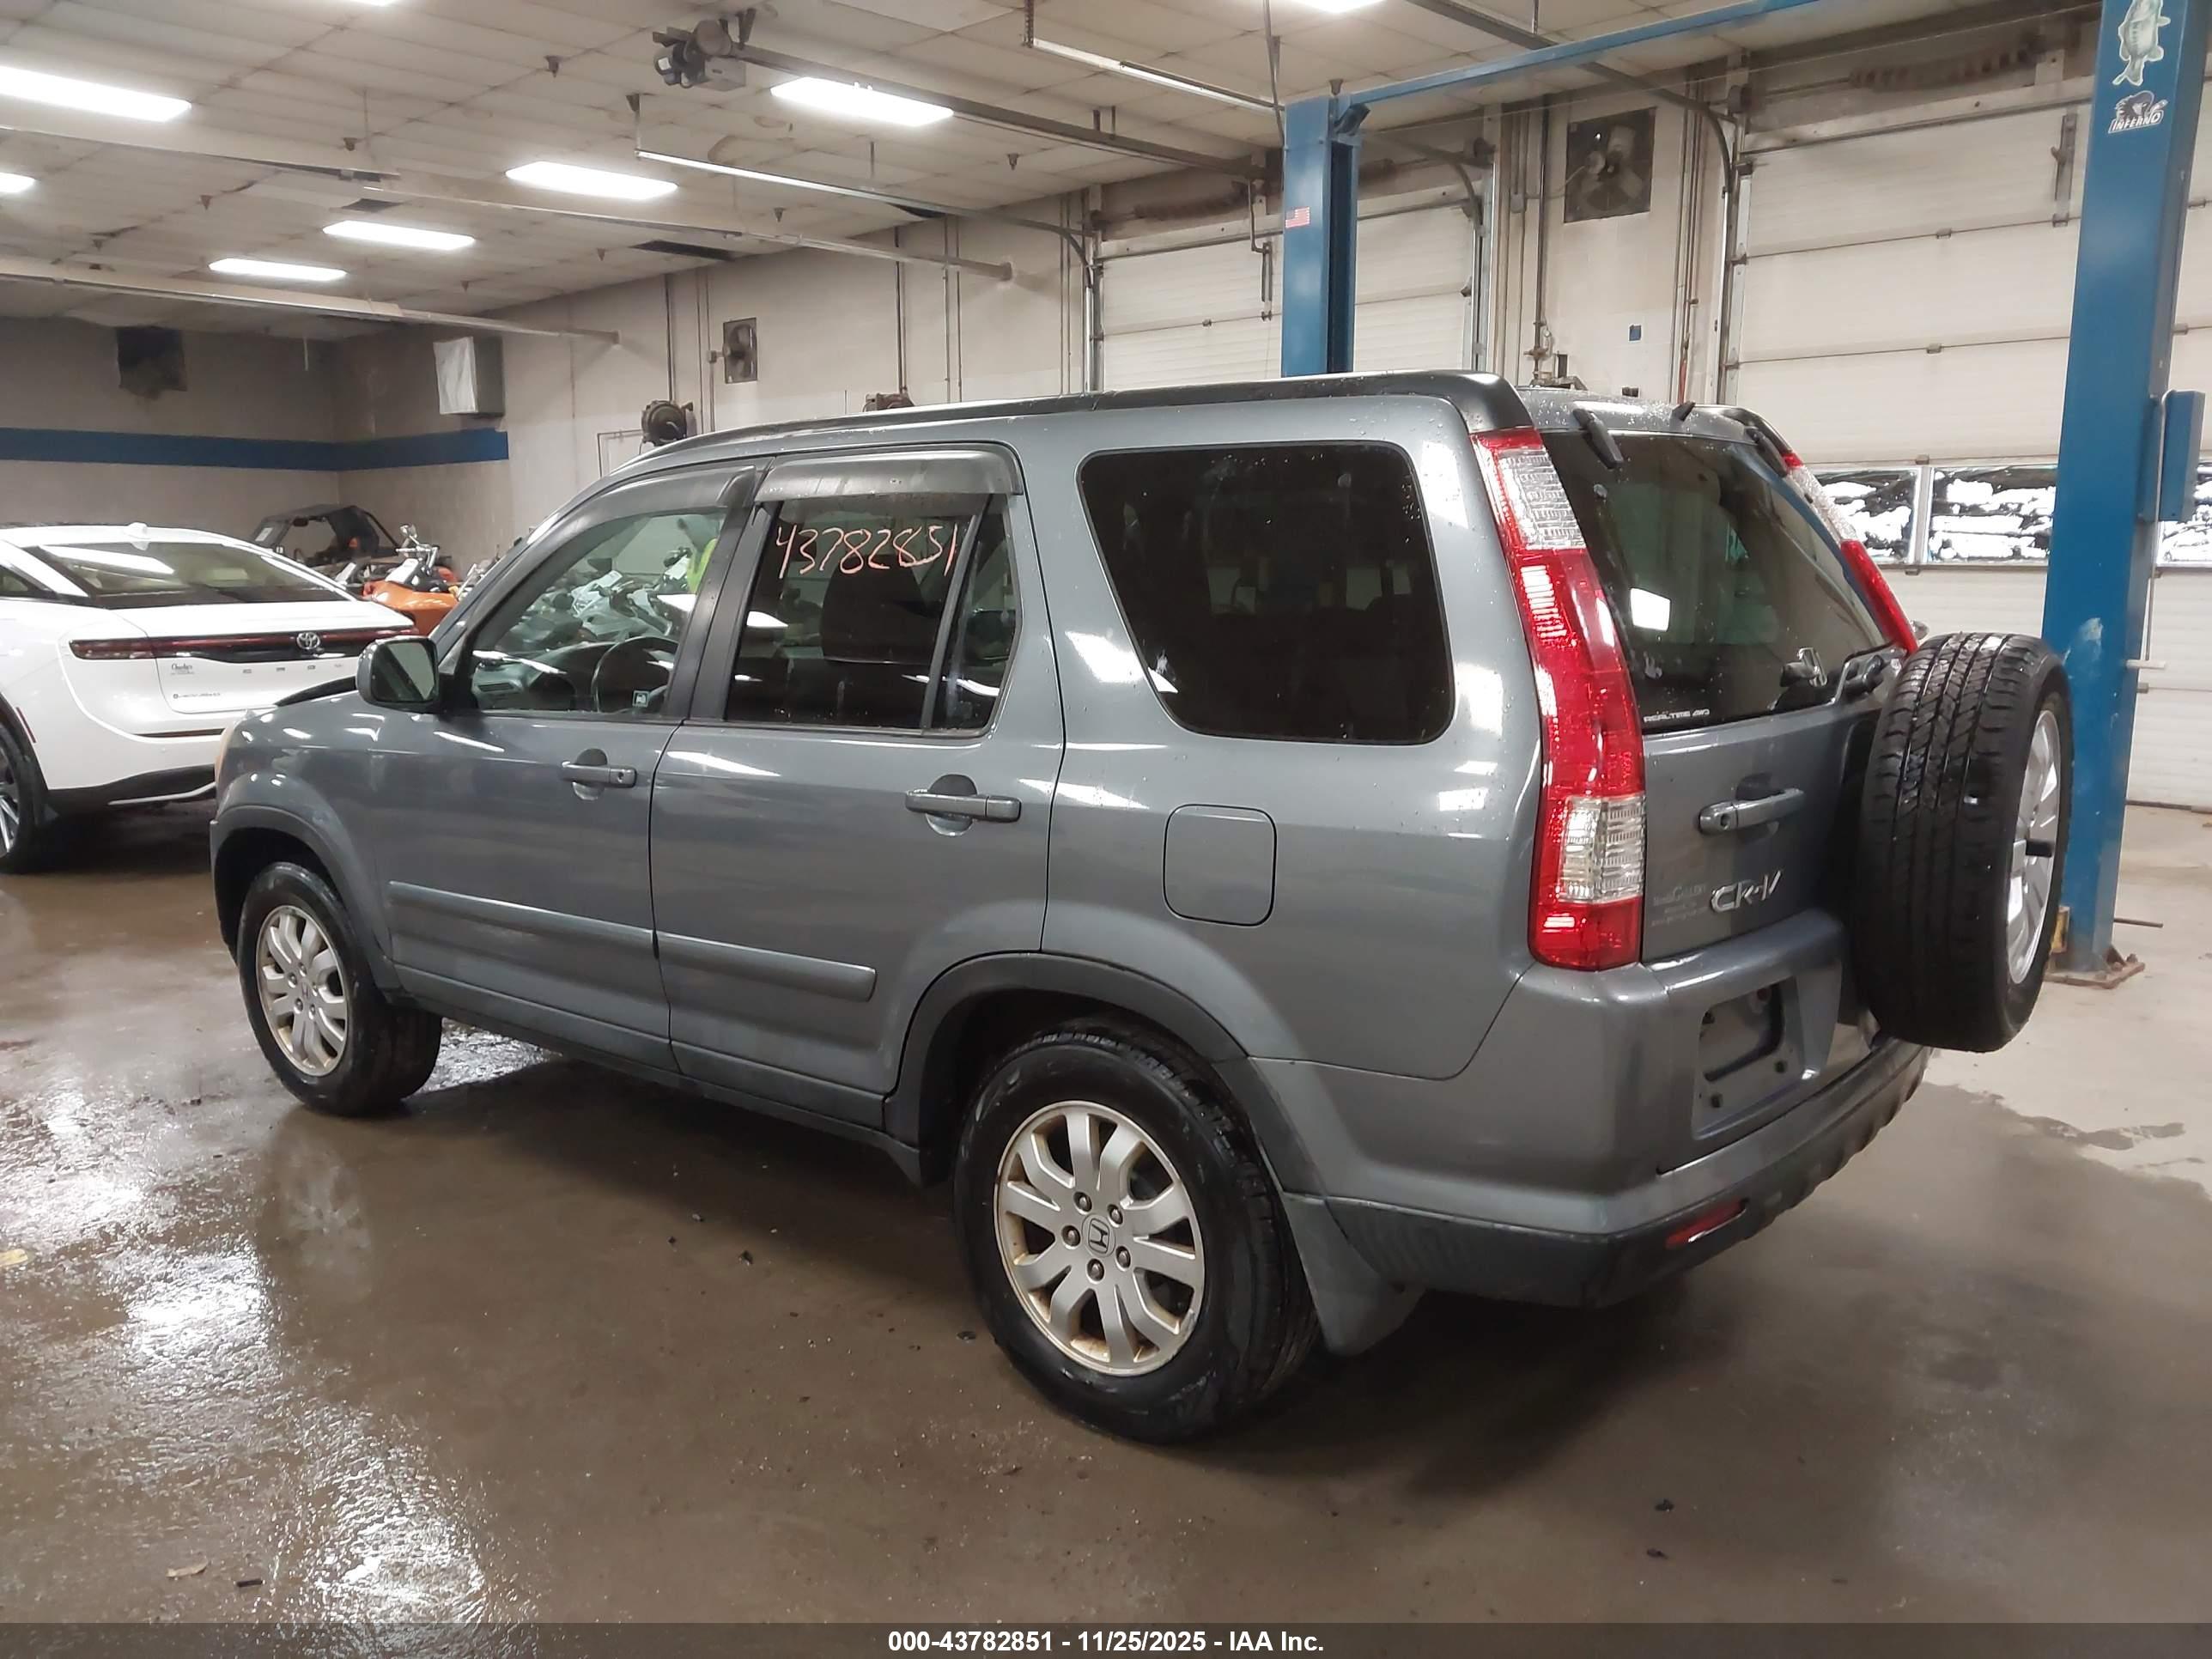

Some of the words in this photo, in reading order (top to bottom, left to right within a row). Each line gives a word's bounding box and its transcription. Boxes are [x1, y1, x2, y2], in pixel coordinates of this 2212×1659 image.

[2112, 112, 2161, 131] INFERNO
[776, 523, 958, 579] 43782851
[1711, 870, 1782, 913] CR-V
